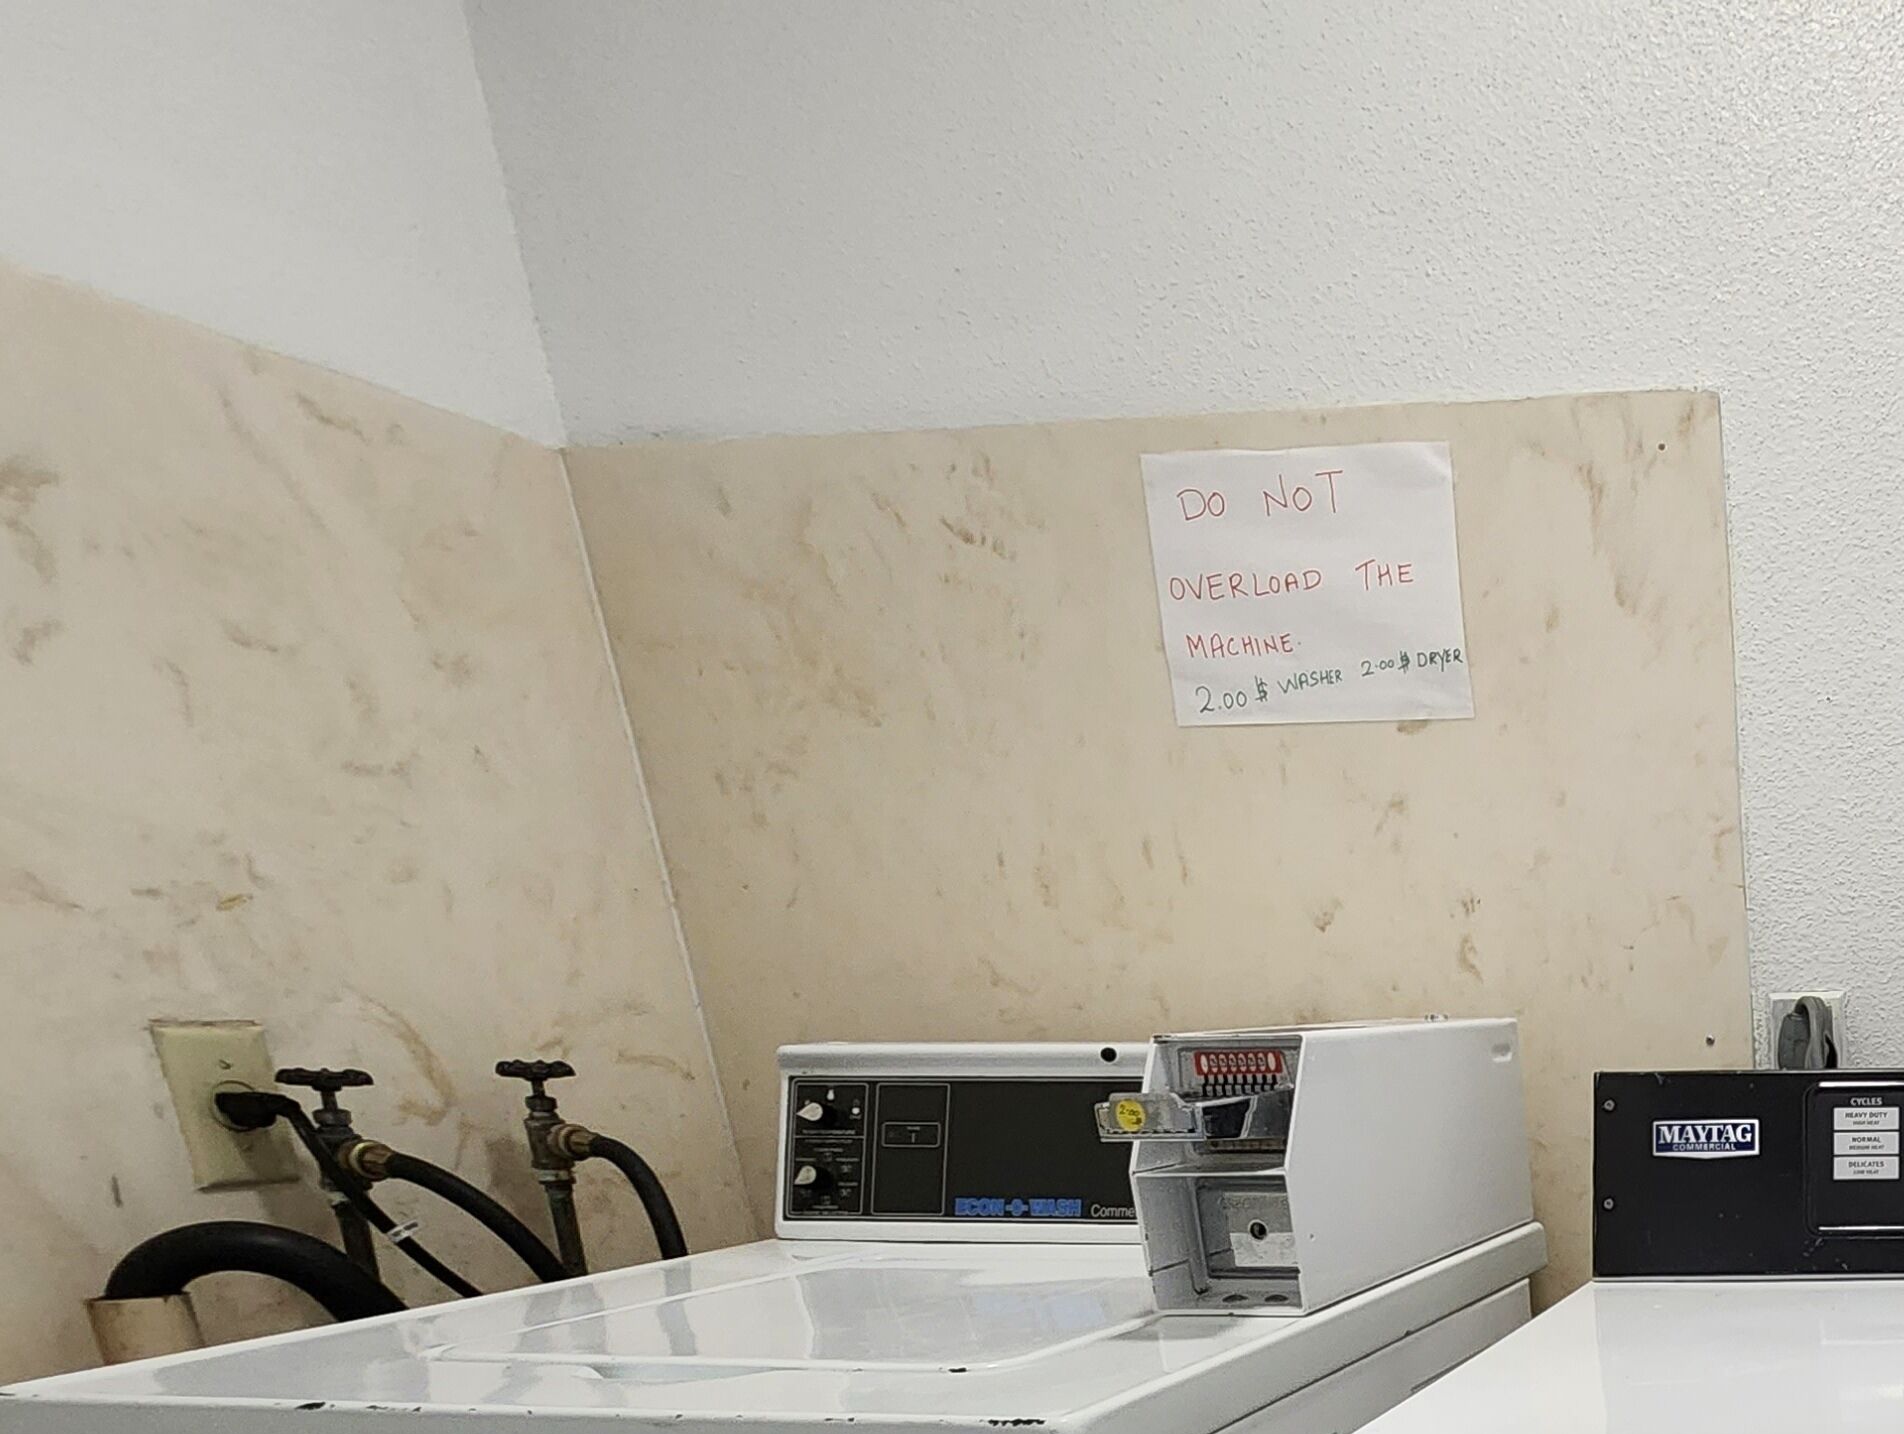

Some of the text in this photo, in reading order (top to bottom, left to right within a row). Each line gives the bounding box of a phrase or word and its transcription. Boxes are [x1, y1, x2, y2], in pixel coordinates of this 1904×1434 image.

[1177, 470, 1343, 521] DO NOT
[1169, 559, 1415, 602] OVERLOAD THE
[1277, 670, 1343, 694] WASHER
[1416, 648, 1463, 672] DRYER
[1850, 1097, 1882, 1106] CYCLES
[1658, 1124, 1753, 1144] MAYTAG
[1672, 1142, 1737, 1152] COMMERCIAL
